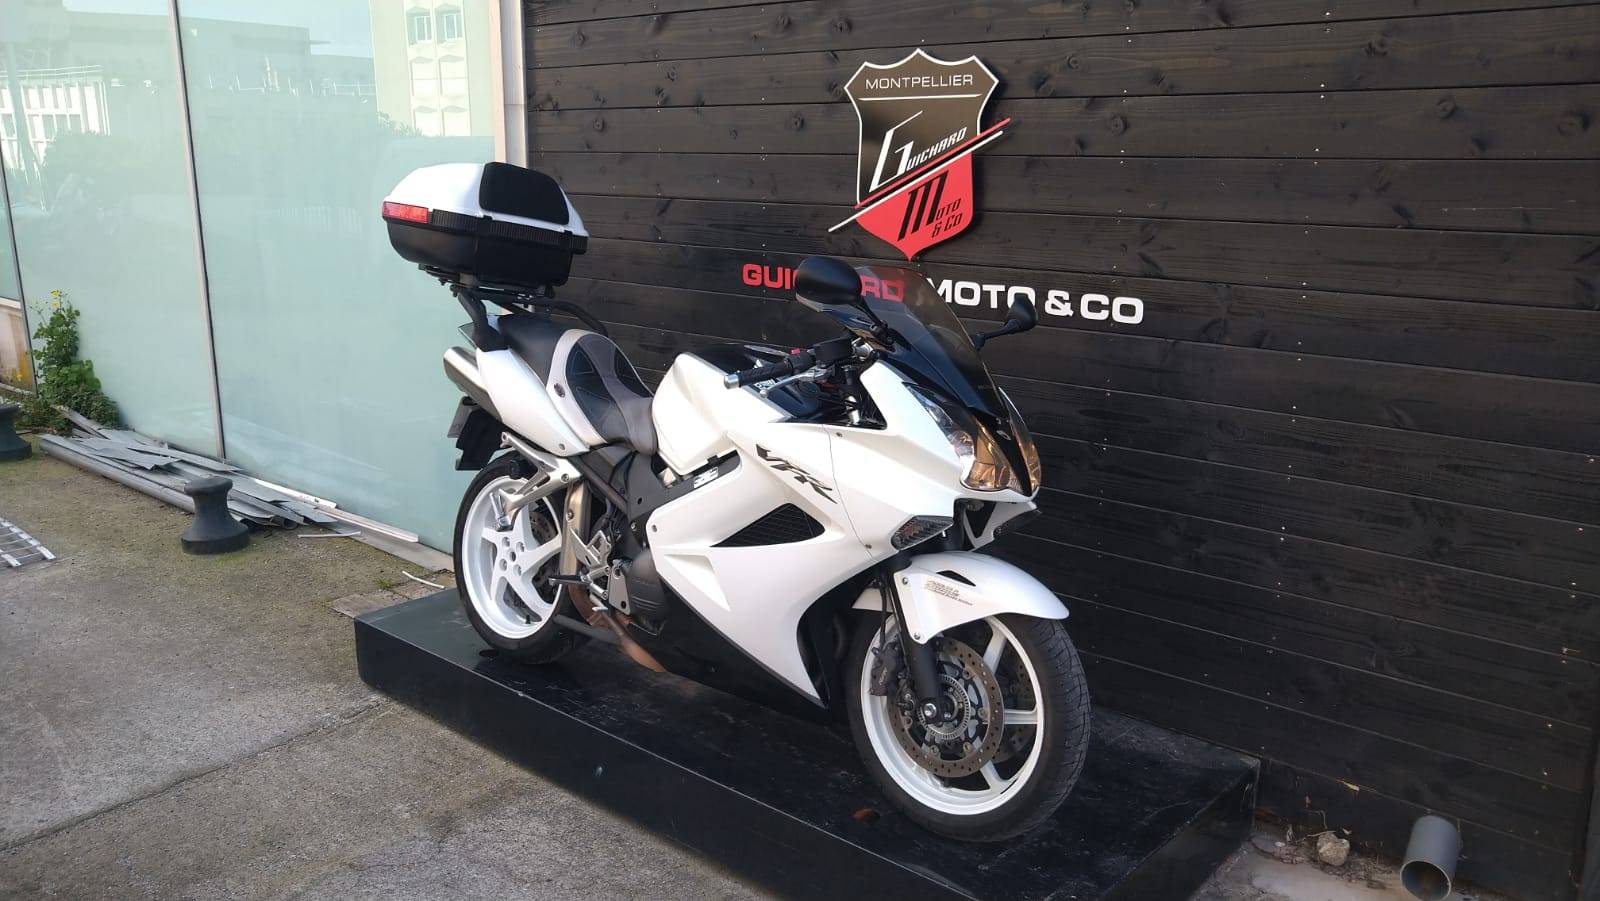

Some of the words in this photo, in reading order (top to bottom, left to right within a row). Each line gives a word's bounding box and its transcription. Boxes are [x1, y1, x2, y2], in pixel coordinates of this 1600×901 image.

[865, 74, 973, 90] MONTPELLIER
[932, 221, 943, 238] &
[742, 263, 904, 303] GUIRD
[1044, 289, 1074, 317] &
[1080, 293, 1144, 325] CO
